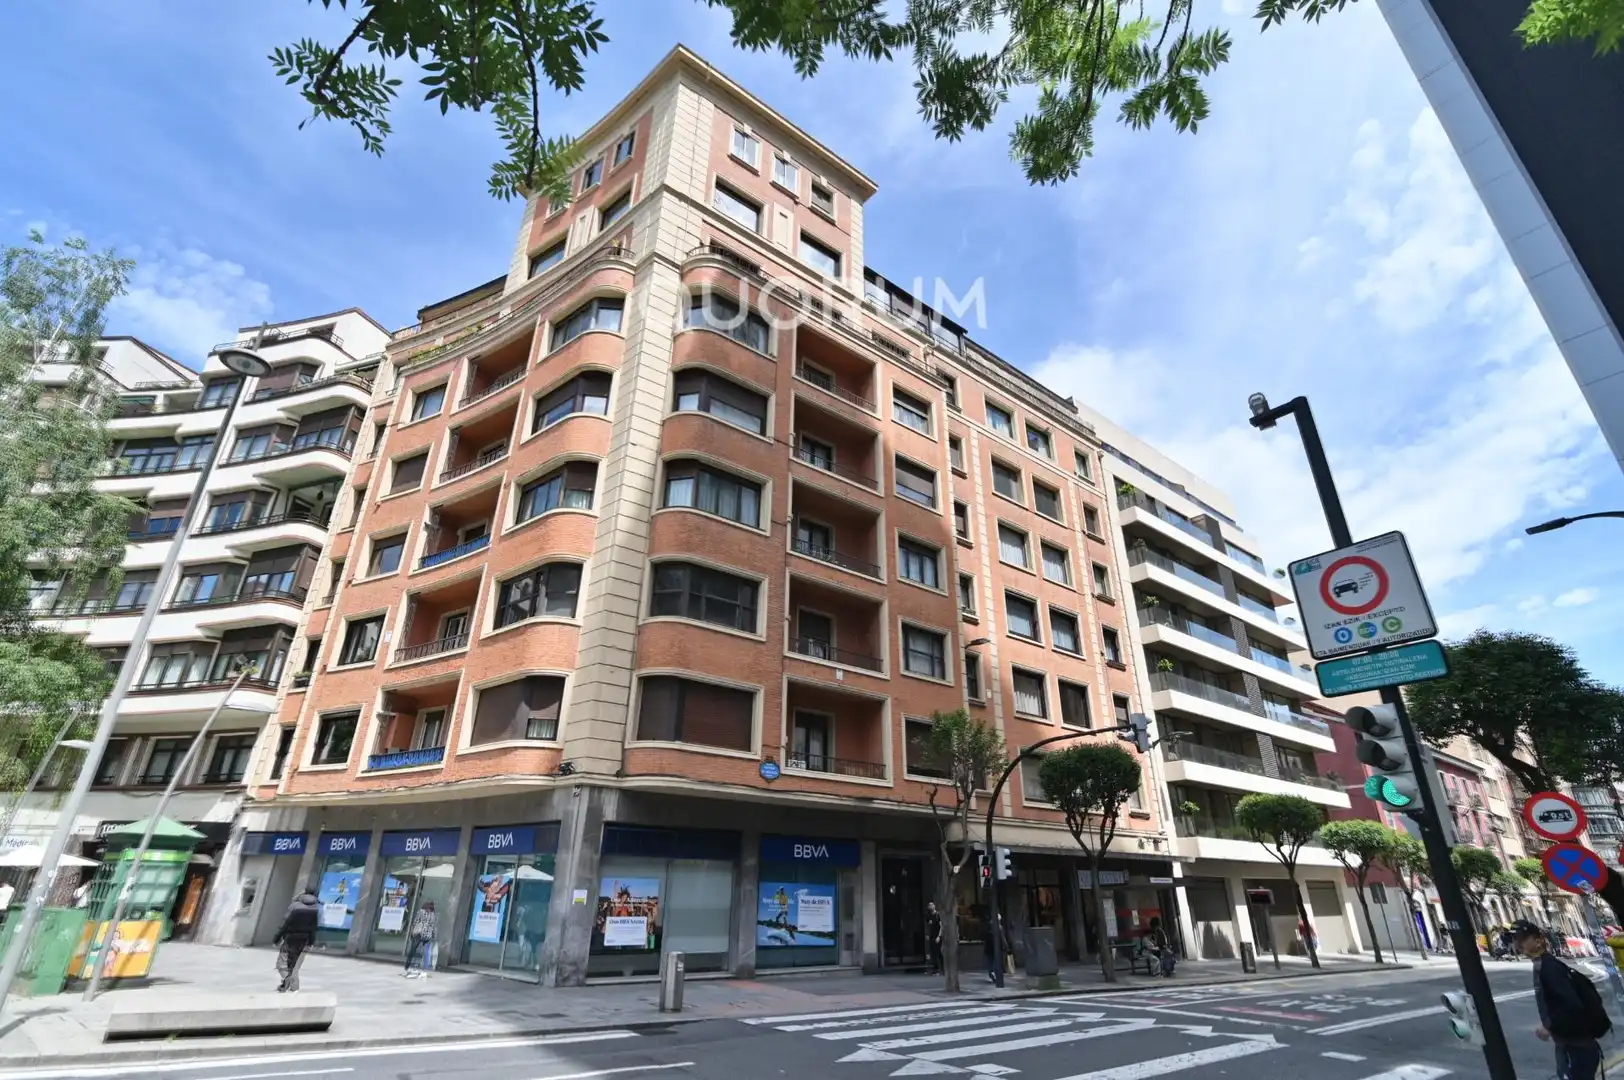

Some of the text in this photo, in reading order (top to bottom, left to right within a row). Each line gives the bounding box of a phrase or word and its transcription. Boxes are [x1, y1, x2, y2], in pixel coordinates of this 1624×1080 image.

[274, 838, 301, 850] BBVA
[330, 837, 356, 850] BBVA
[405, 836, 431, 851] BBVA
[487, 832, 514, 848] BBVA
[794, 844, 829, 858] BBVA
